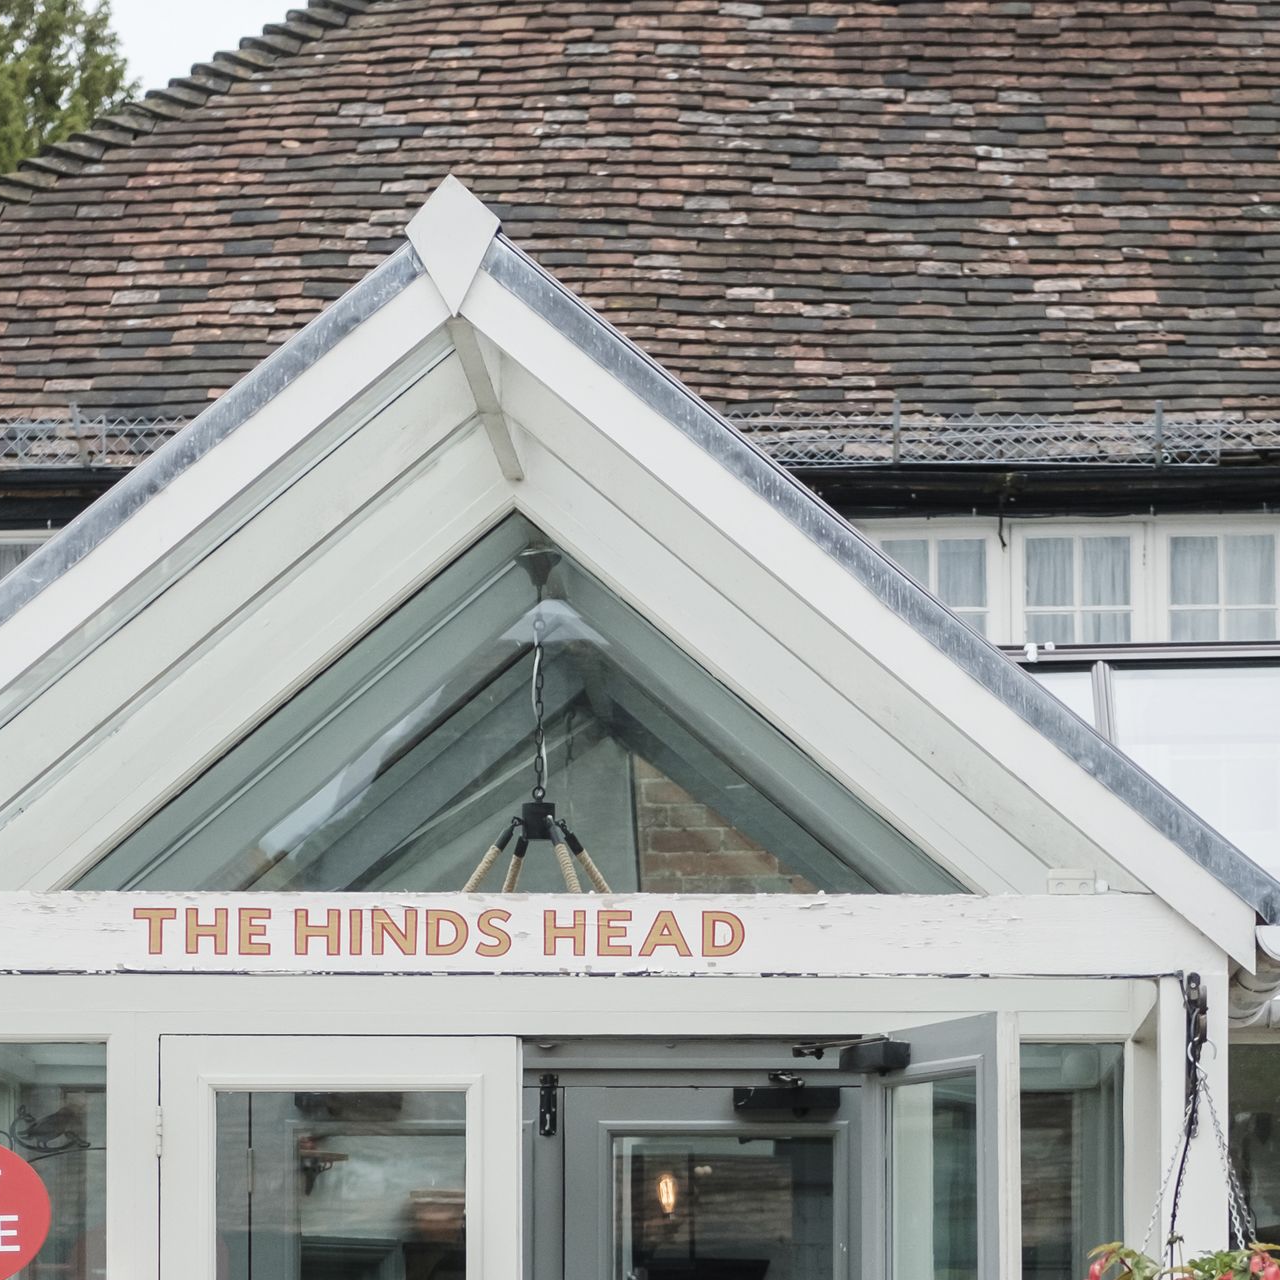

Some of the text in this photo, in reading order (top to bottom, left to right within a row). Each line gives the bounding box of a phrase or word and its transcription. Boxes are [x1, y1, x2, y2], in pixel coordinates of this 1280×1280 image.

[133, 907, 747, 958] THE HINDS HEAD
